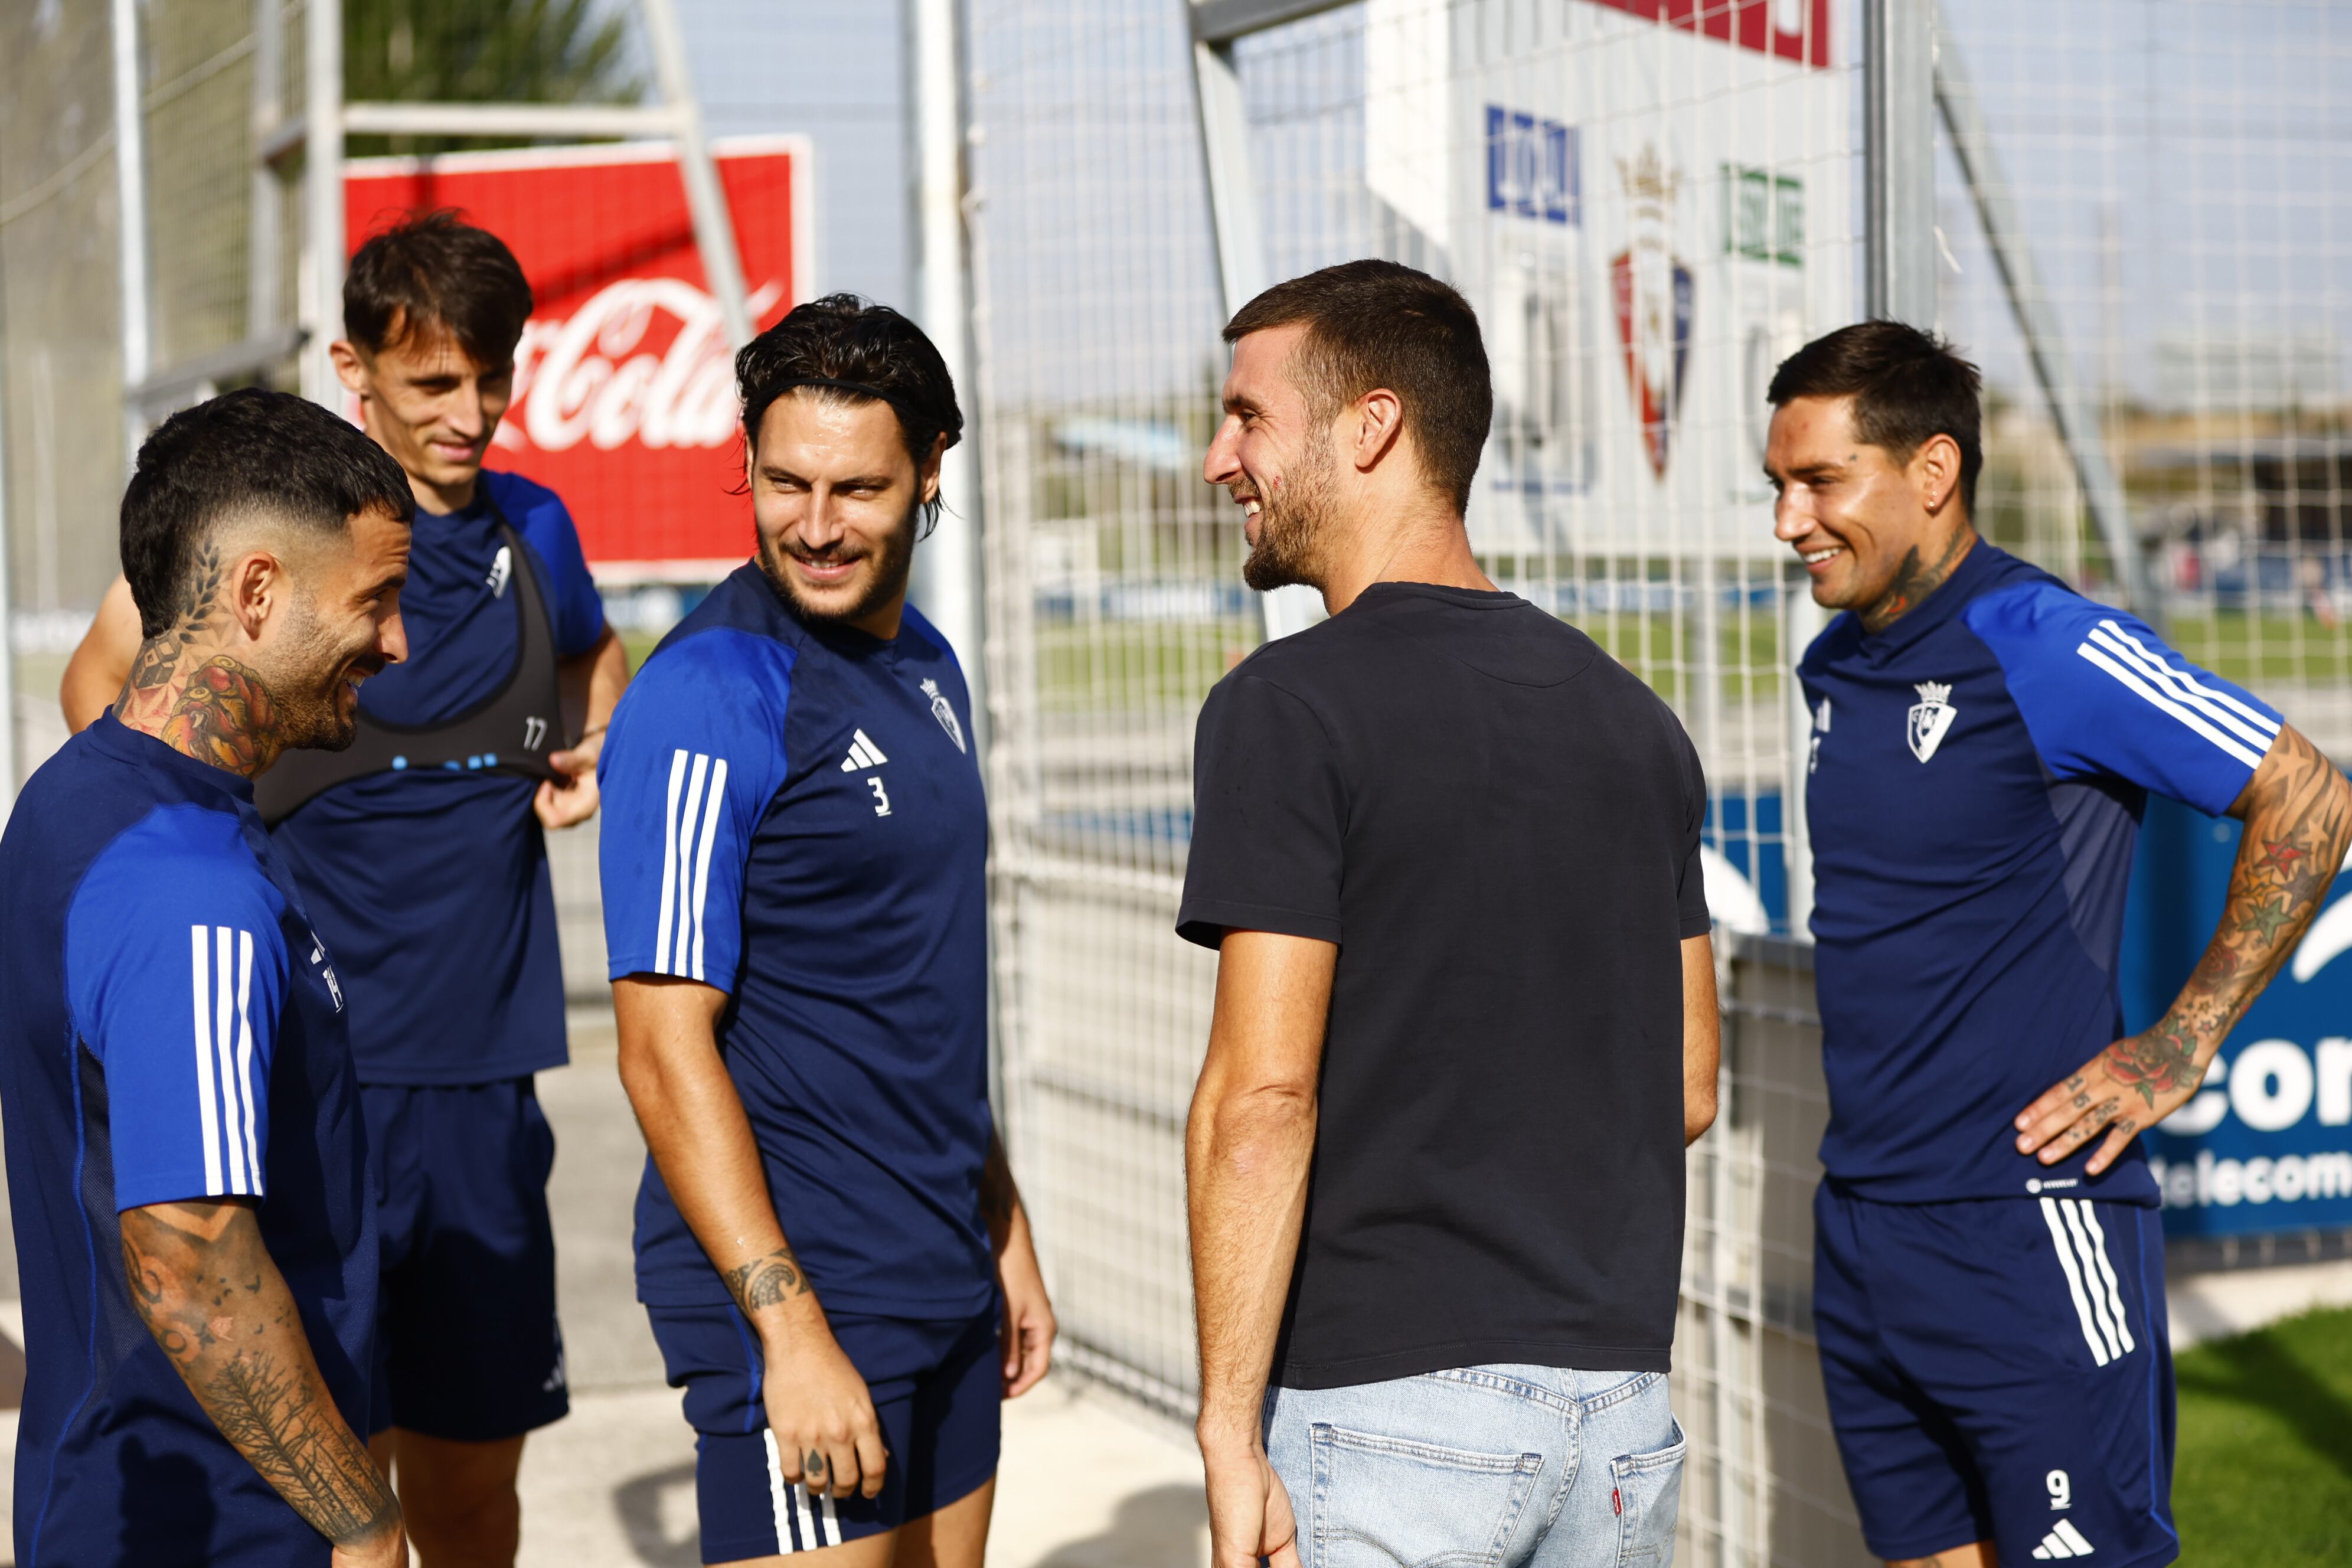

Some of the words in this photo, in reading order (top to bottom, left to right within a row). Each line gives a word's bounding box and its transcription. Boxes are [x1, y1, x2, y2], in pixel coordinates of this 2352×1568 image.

[523, 716, 548, 751] 17
[867, 776, 890, 814] 3
[2046, 1469, 2072, 1507] 9
